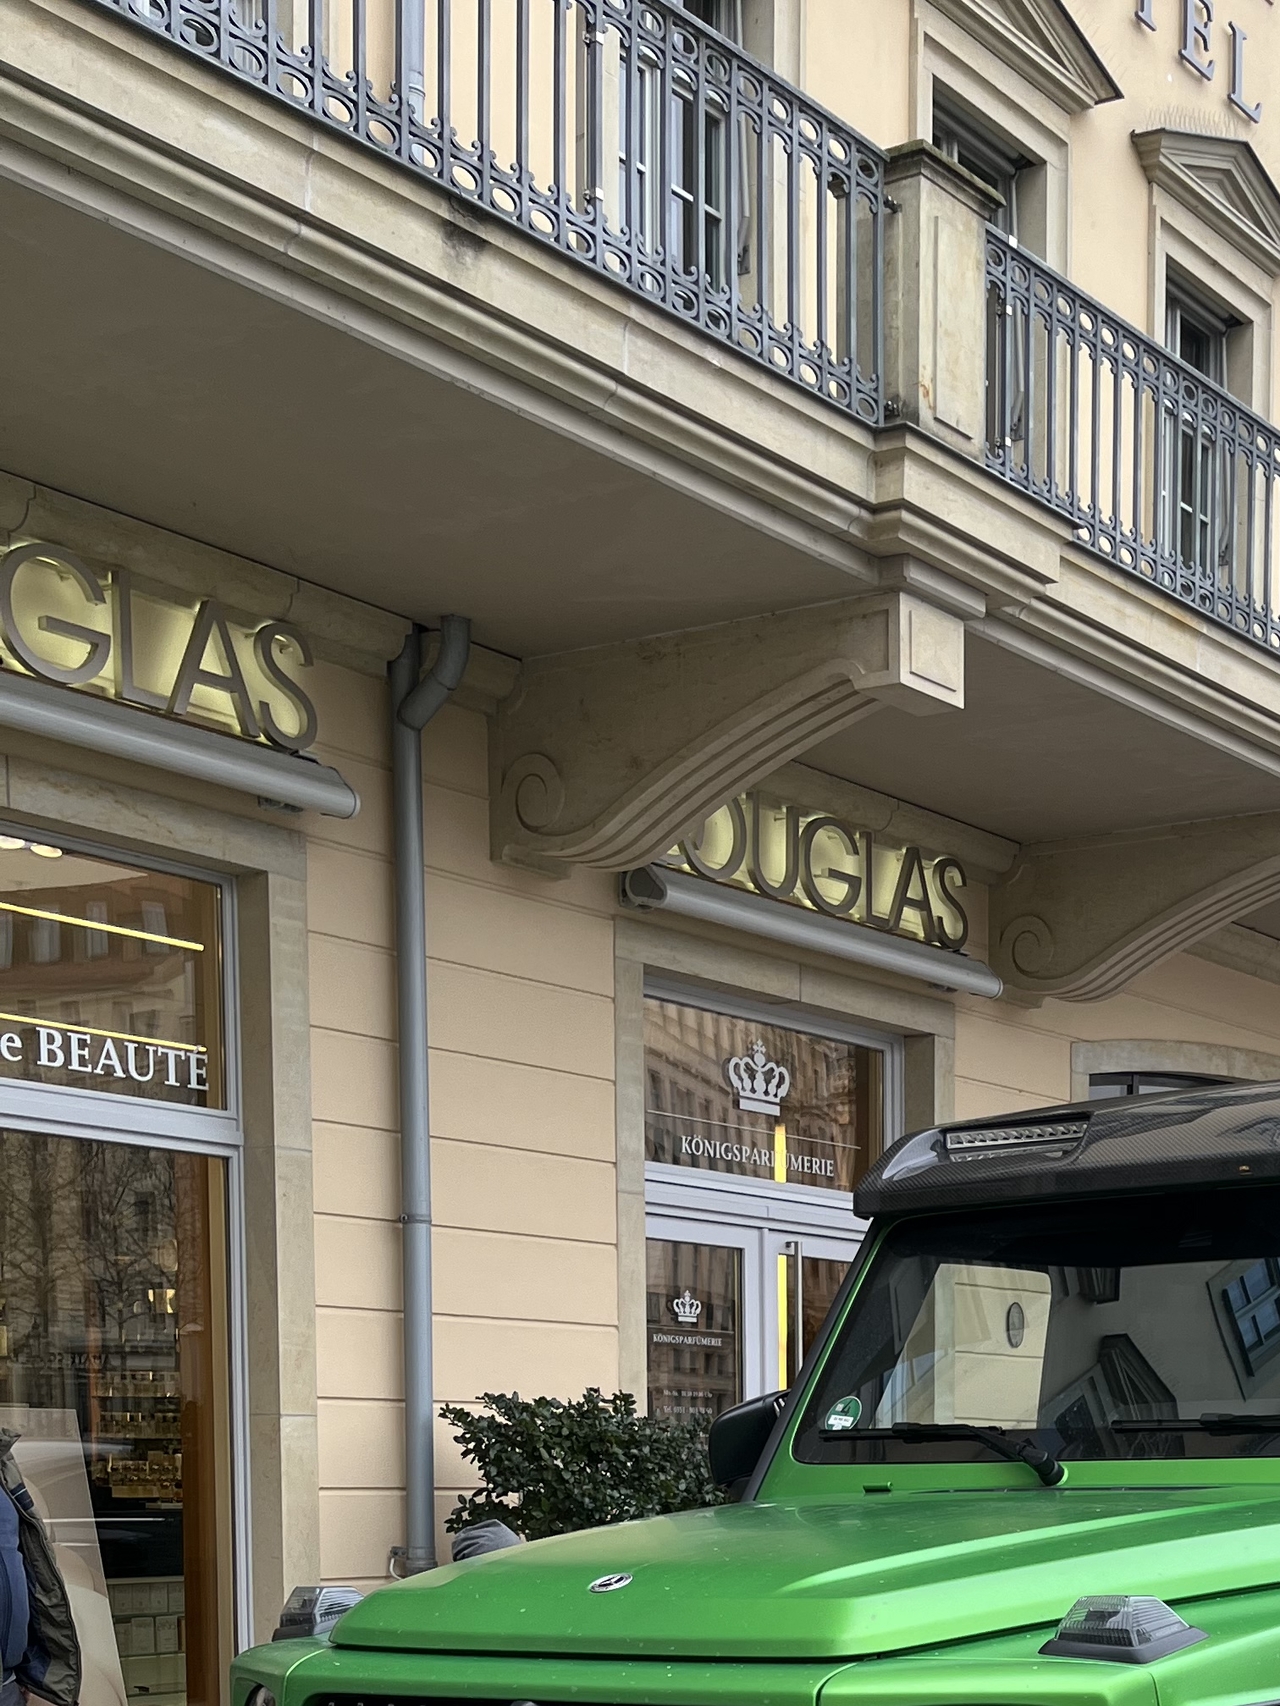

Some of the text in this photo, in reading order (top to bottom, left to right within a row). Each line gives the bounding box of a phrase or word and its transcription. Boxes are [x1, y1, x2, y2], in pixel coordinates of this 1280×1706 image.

[1135, 0, 1262, 123] EL
[660, 788, 969, 950] OUGLAS
[36, 1026, 209, 1091] BEAUTÉ
